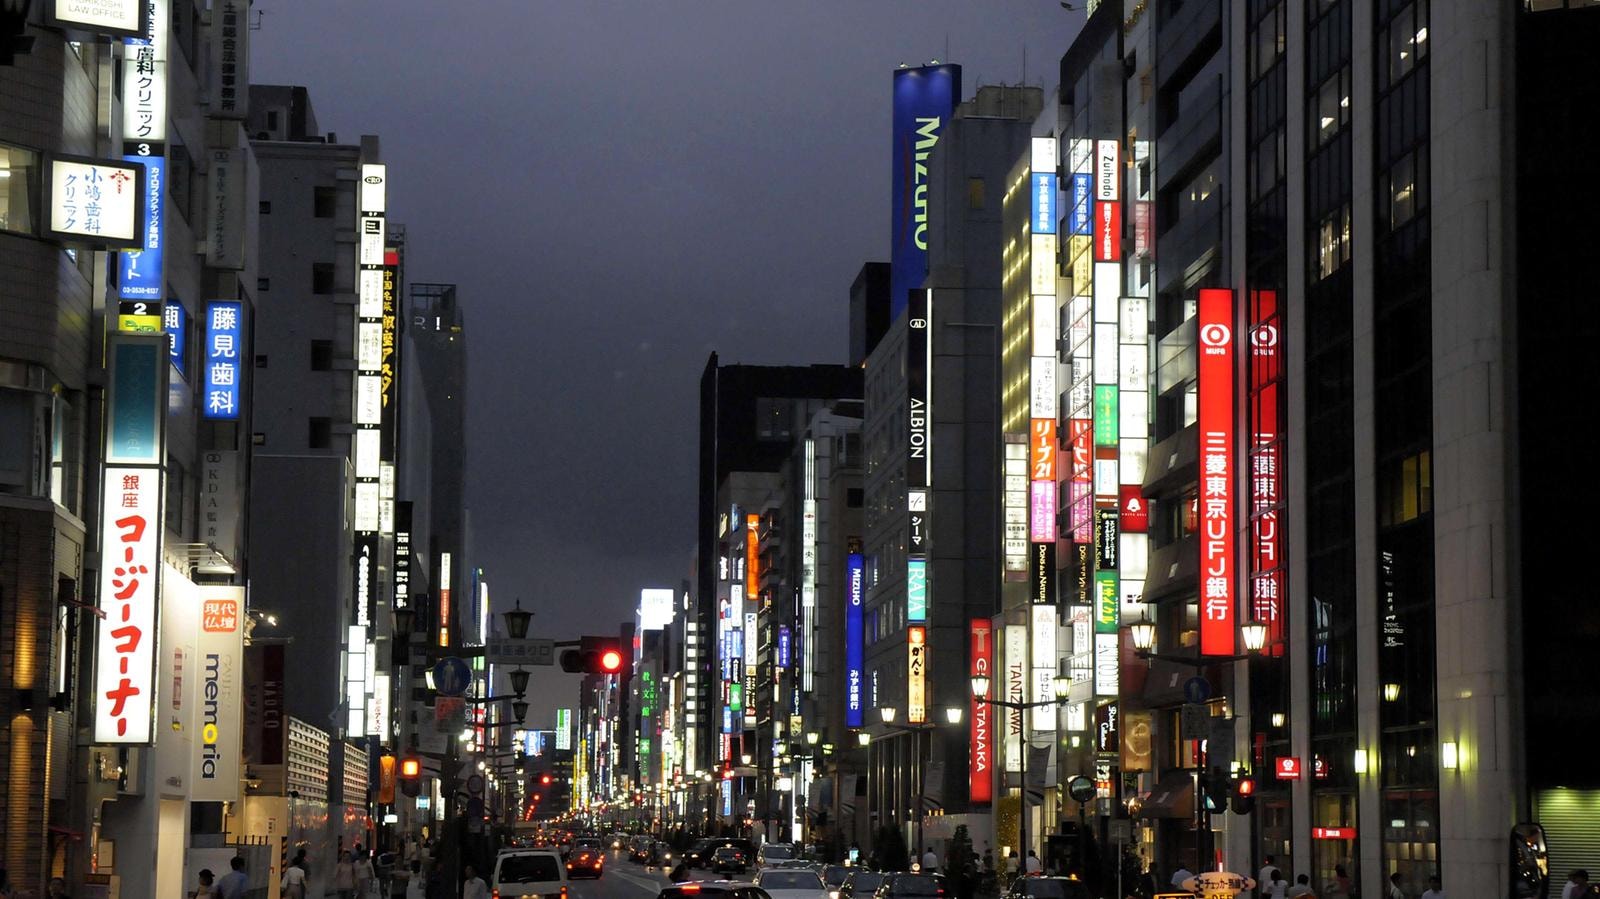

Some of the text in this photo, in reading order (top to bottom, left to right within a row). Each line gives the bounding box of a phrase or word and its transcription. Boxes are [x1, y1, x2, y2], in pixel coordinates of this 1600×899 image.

[68, 5, 125, 19] LAW OFFICE
[138, 143, 150, 156] 3
[63, 175, 76, 230] クリニック
[85, 167, 103, 234] 小嶋歯科
[134, 302, 147, 315] 2
[210, 307, 236, 414] 藤見歯科
[910, 398, 924, 458] ALBION
[1035, 421, 1052, 478] リーブ21
[122, 475, 140, 508] 銀座
[911, 516, 922, 546] シーマ
[1206, 432, 1228, 620] 三菱東京UFJ銀行
[1039, 545, 1047, 564] DONS
[852, 568, 861, 606] MIZUHO
[908, 567, 926, 614] RAJA
[105, 515, 148, 736] コージーコーナー
[204, 603, 236, 616] 現代
[204, 616, 236, 630] 仏壇
[912, 645, 924, 676] がんこ
[850, 670, 859, 711] みずほ銀行
[1010, 662, 1022, 736] TANIZAWA
[202, 653, 220, 779] memoria
